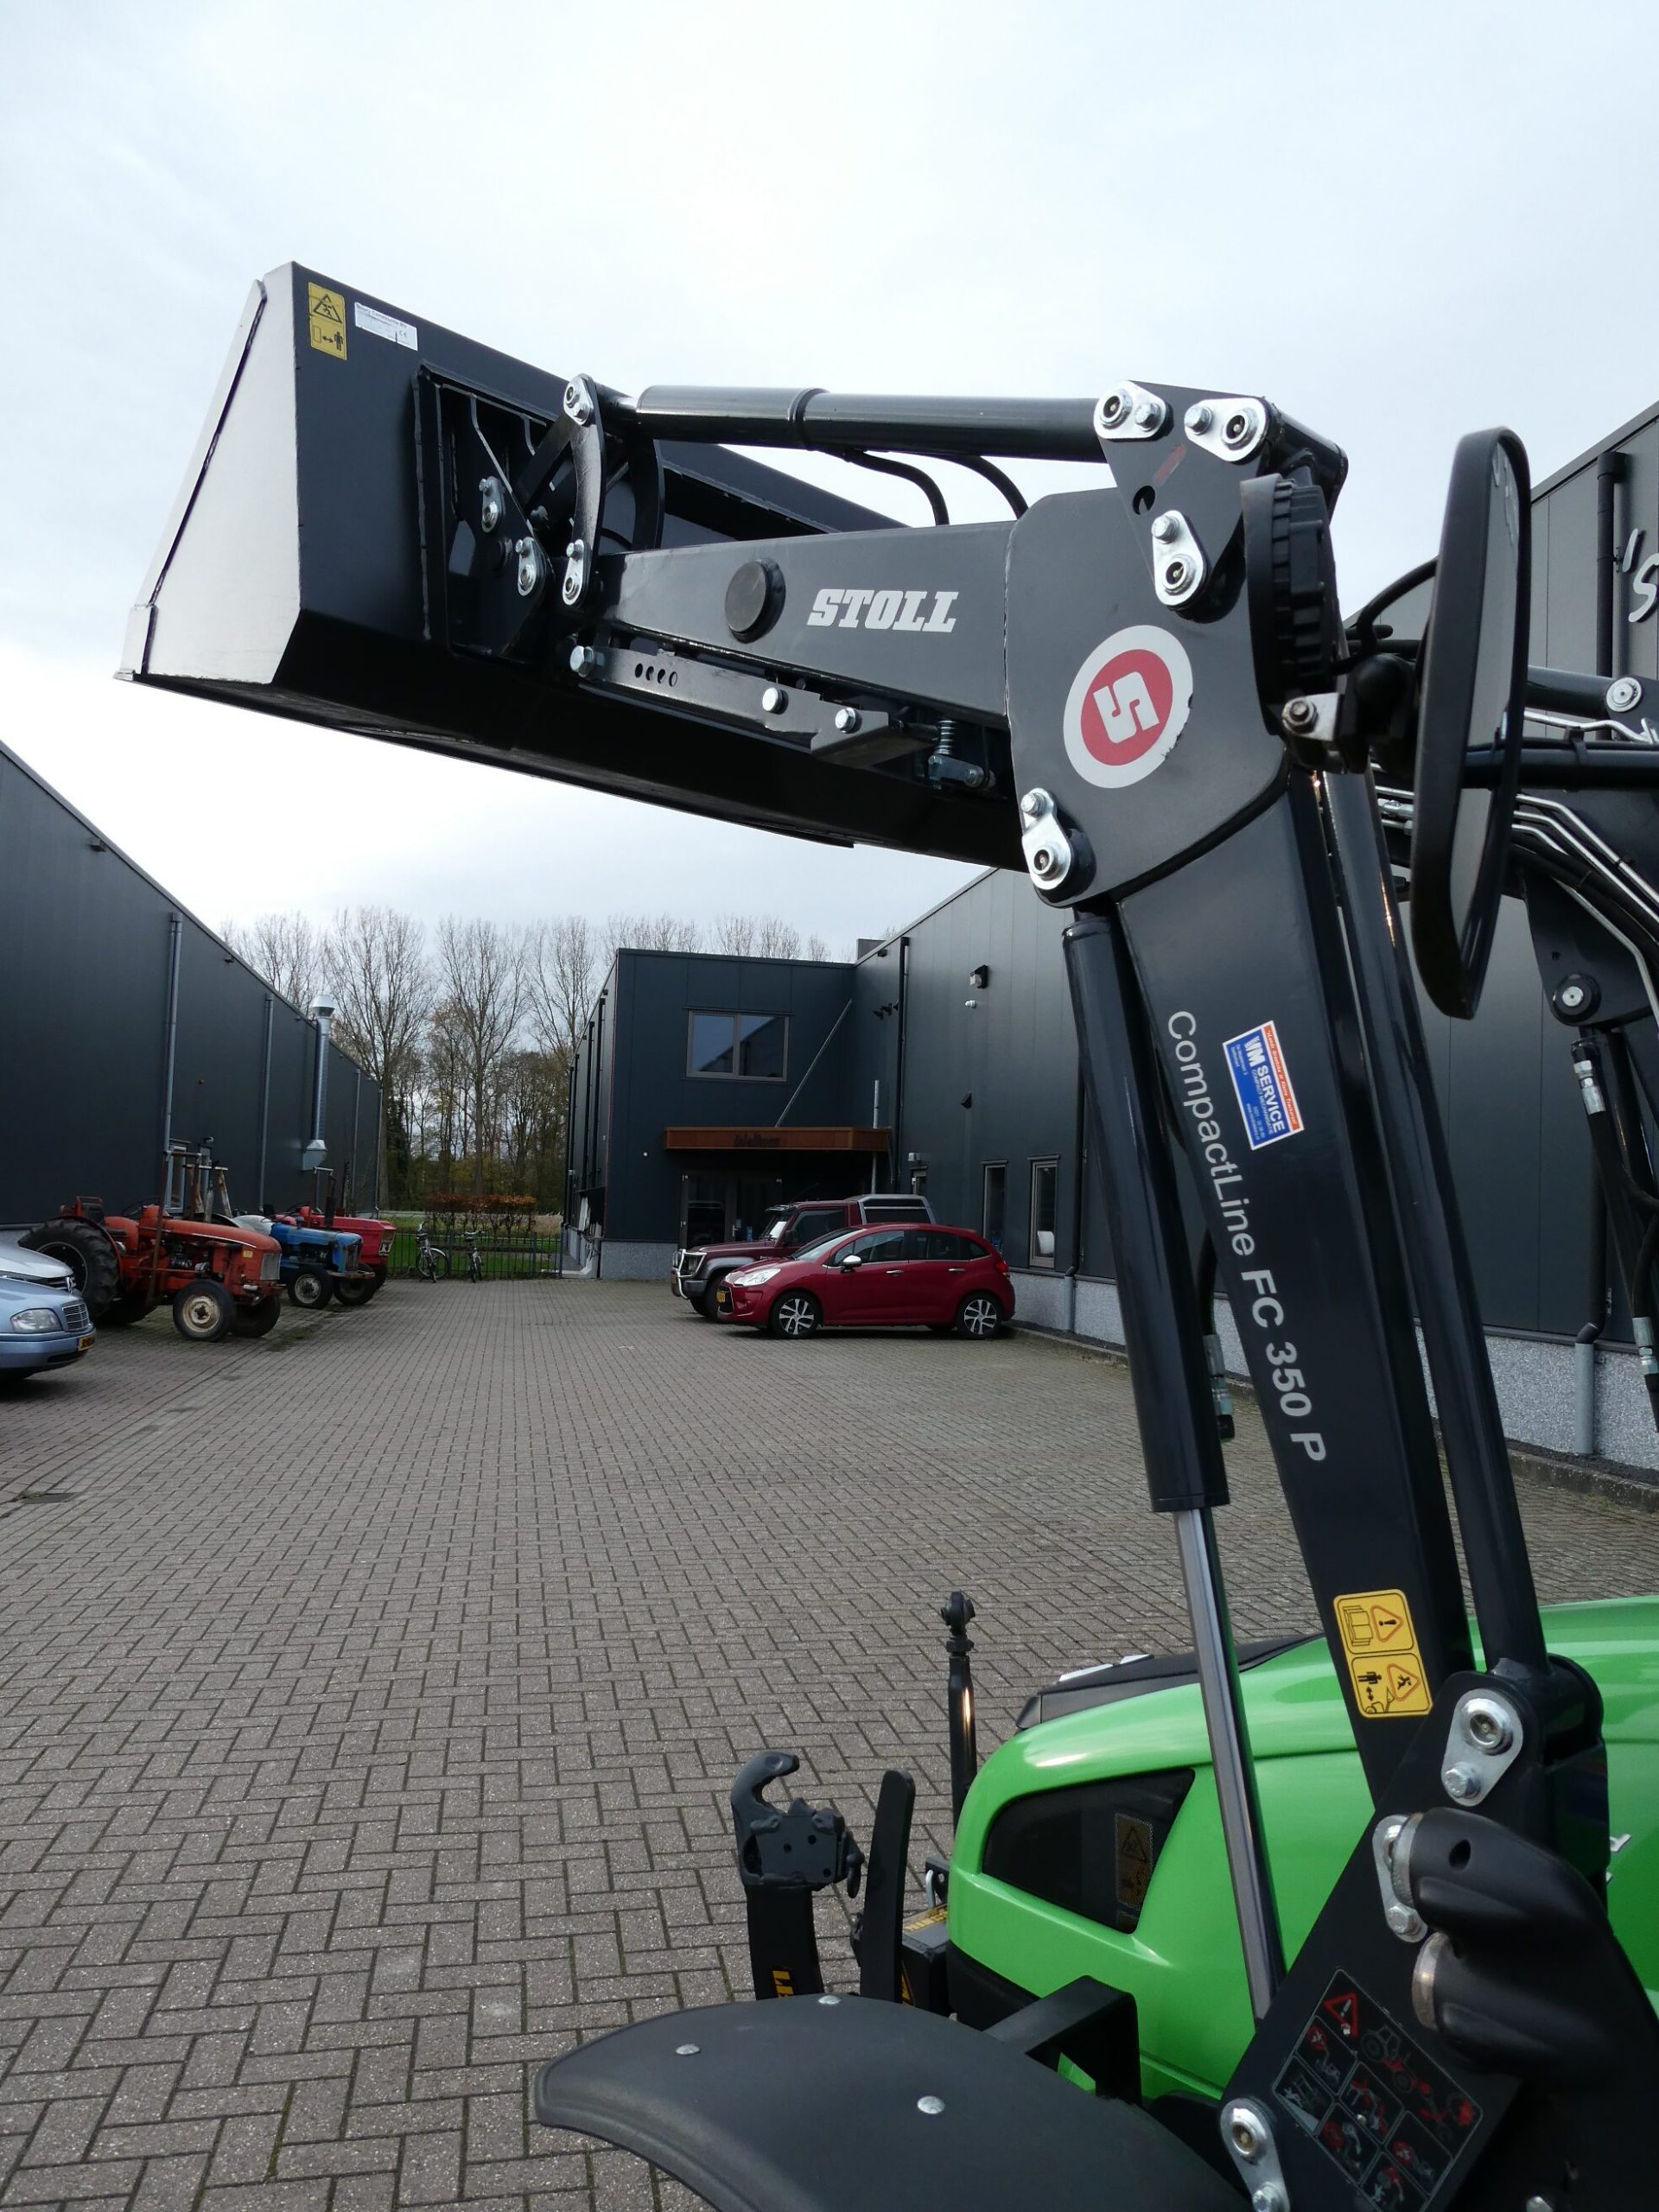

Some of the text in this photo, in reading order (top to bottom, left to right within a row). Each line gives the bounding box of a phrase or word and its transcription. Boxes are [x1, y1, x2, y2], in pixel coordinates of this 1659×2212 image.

[807, 589, 958, 632] STOLL
[1256, 1065, 1286, 1134] SERVICE
[1168, 1011, 1325, 1460] CompactLine FC 350 P
